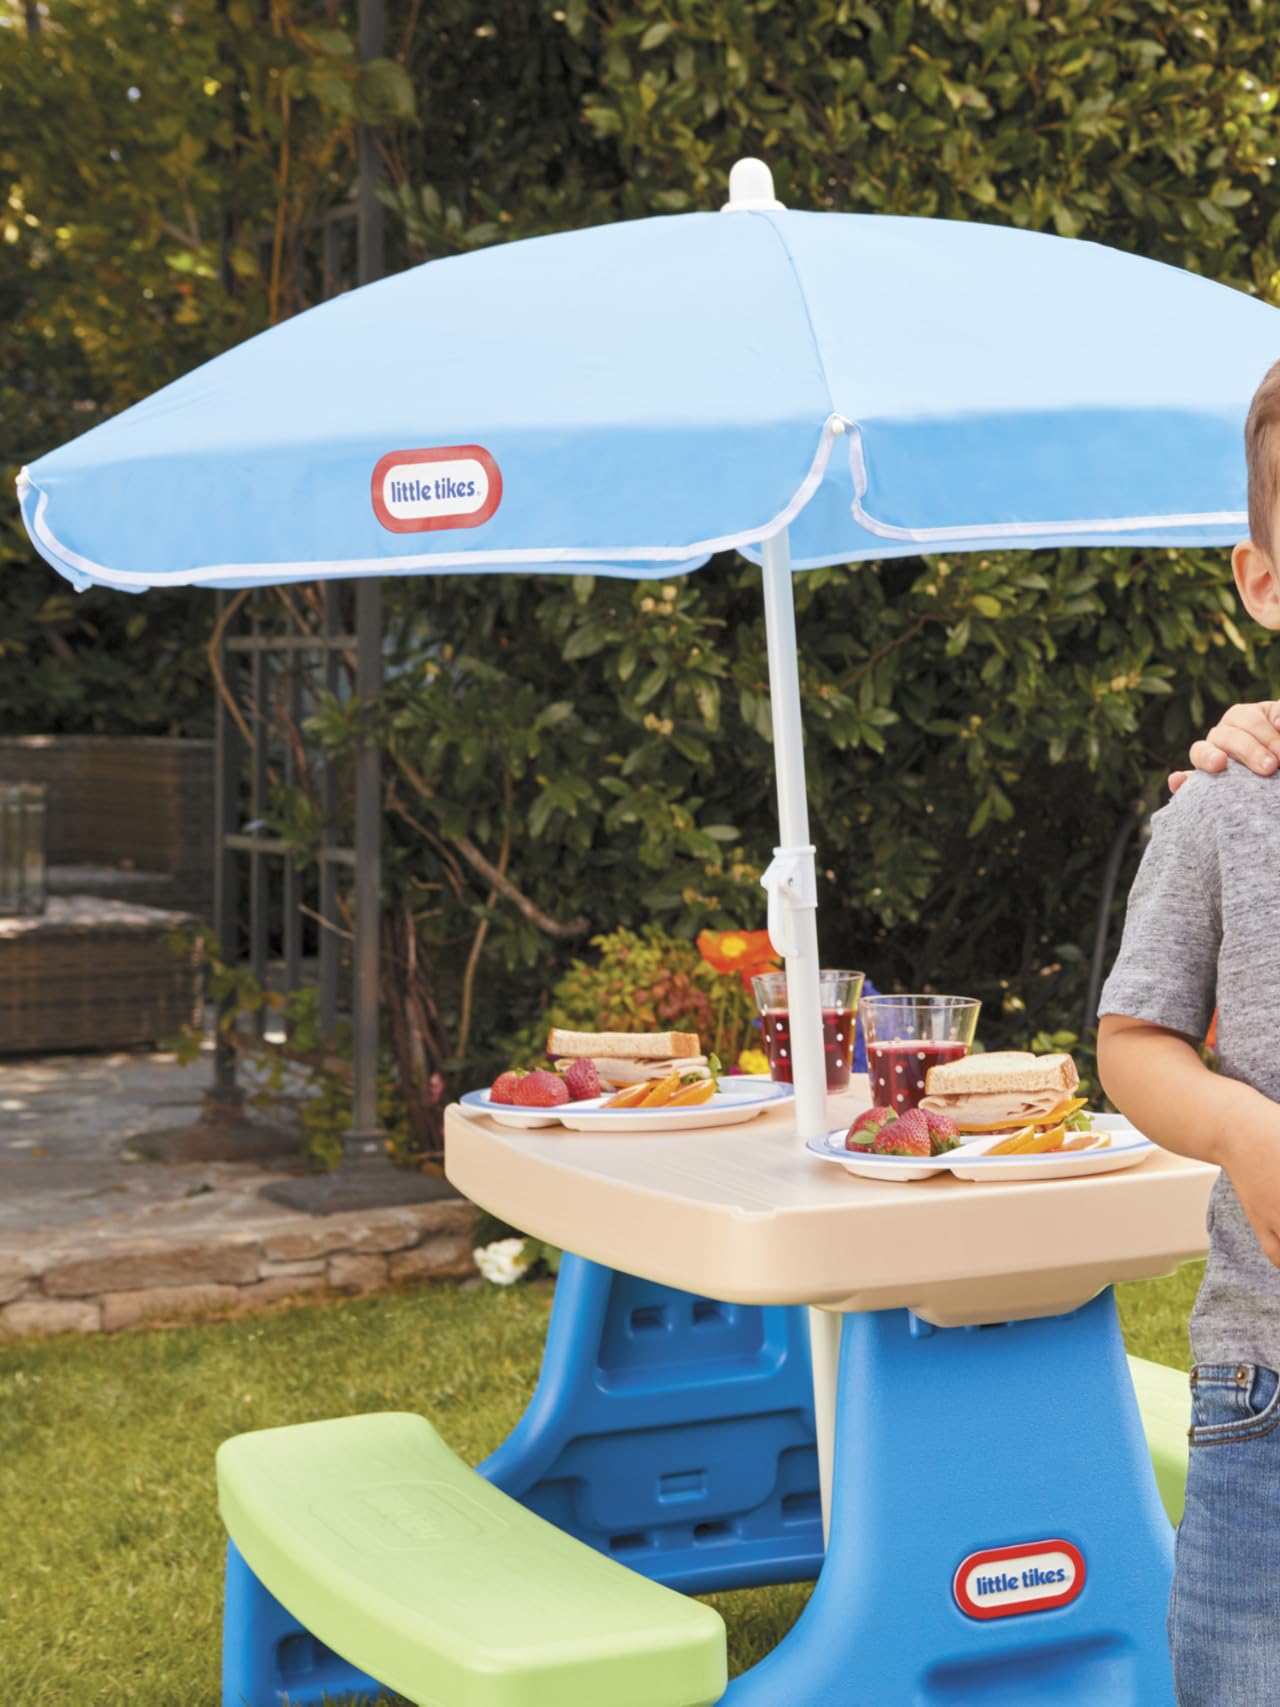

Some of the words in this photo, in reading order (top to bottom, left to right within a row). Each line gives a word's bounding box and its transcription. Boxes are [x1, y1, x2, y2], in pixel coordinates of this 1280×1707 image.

[391, 480, 431, 502] little
[435, 477, 475, 499] tikes
[976, 1573, 1019, 1596] little
[1022, 1568, 1065, 1588] tikes
